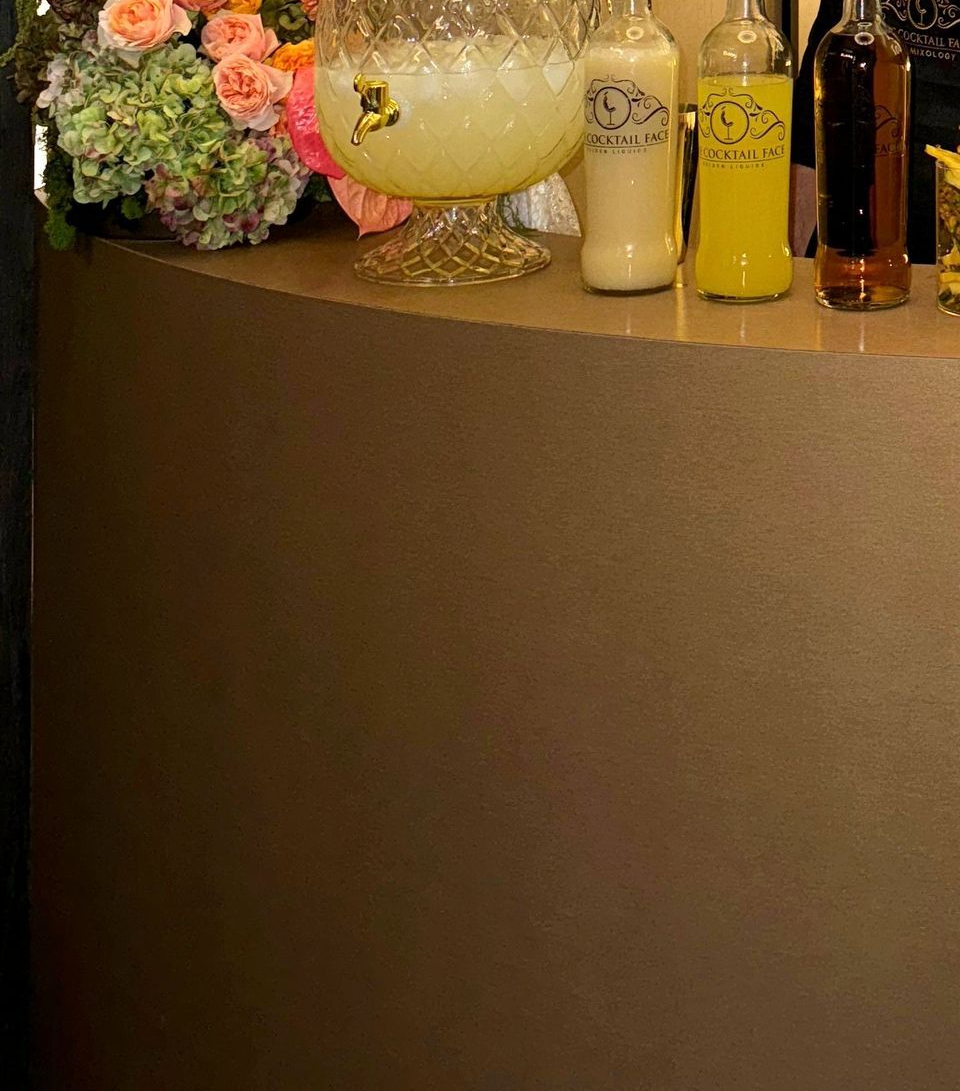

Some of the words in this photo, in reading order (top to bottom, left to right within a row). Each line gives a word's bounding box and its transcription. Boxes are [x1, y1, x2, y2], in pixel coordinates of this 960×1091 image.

[910, 47, 956, 60] MIXOLOGY
[586, 133, 640, 145] COCKTAIL
[645, 130, 669, 143] FACE
[703, 147, 758, 160] COCKTAIL
